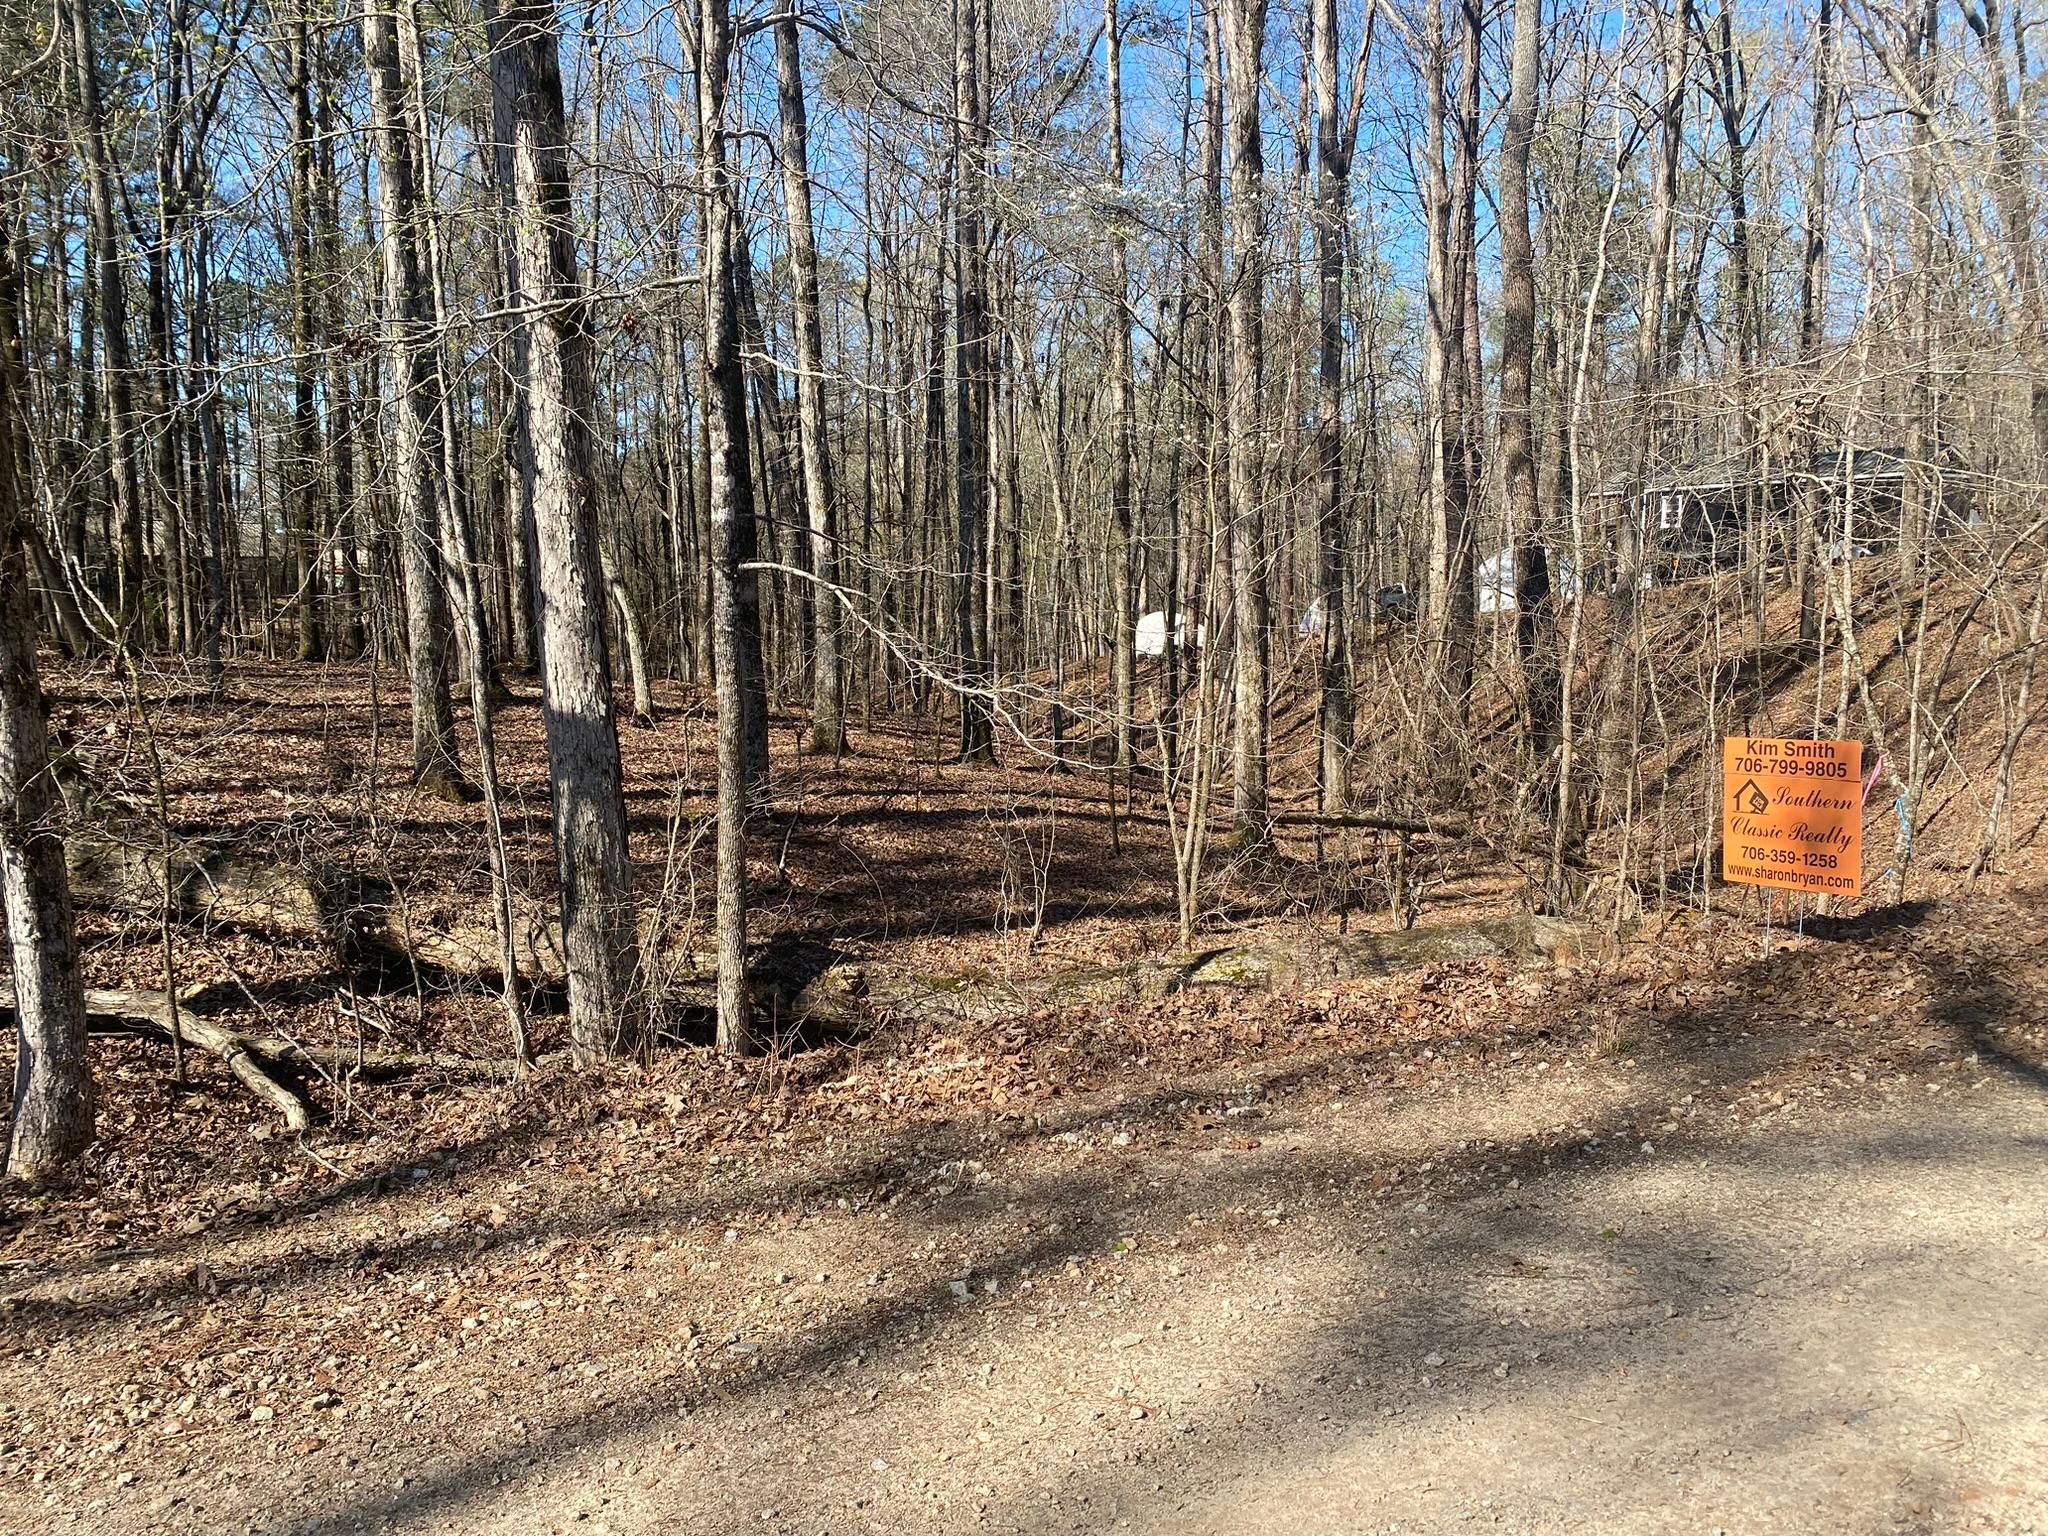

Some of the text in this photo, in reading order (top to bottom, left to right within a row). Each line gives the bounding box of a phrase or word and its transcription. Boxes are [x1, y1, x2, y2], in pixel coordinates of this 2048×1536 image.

[1746, 740, 1835, 758] Kim Smith
[1735, 757, 1847, 778] 706-799-9805
[1772, 786, 1854, 810] Southern
[1731, 816, 1854, 853] Classic Realty
[1741, 845, 1838, 869] 706-359-1258
[1728, 864, 1854, 889] www.sharonbryan.com
